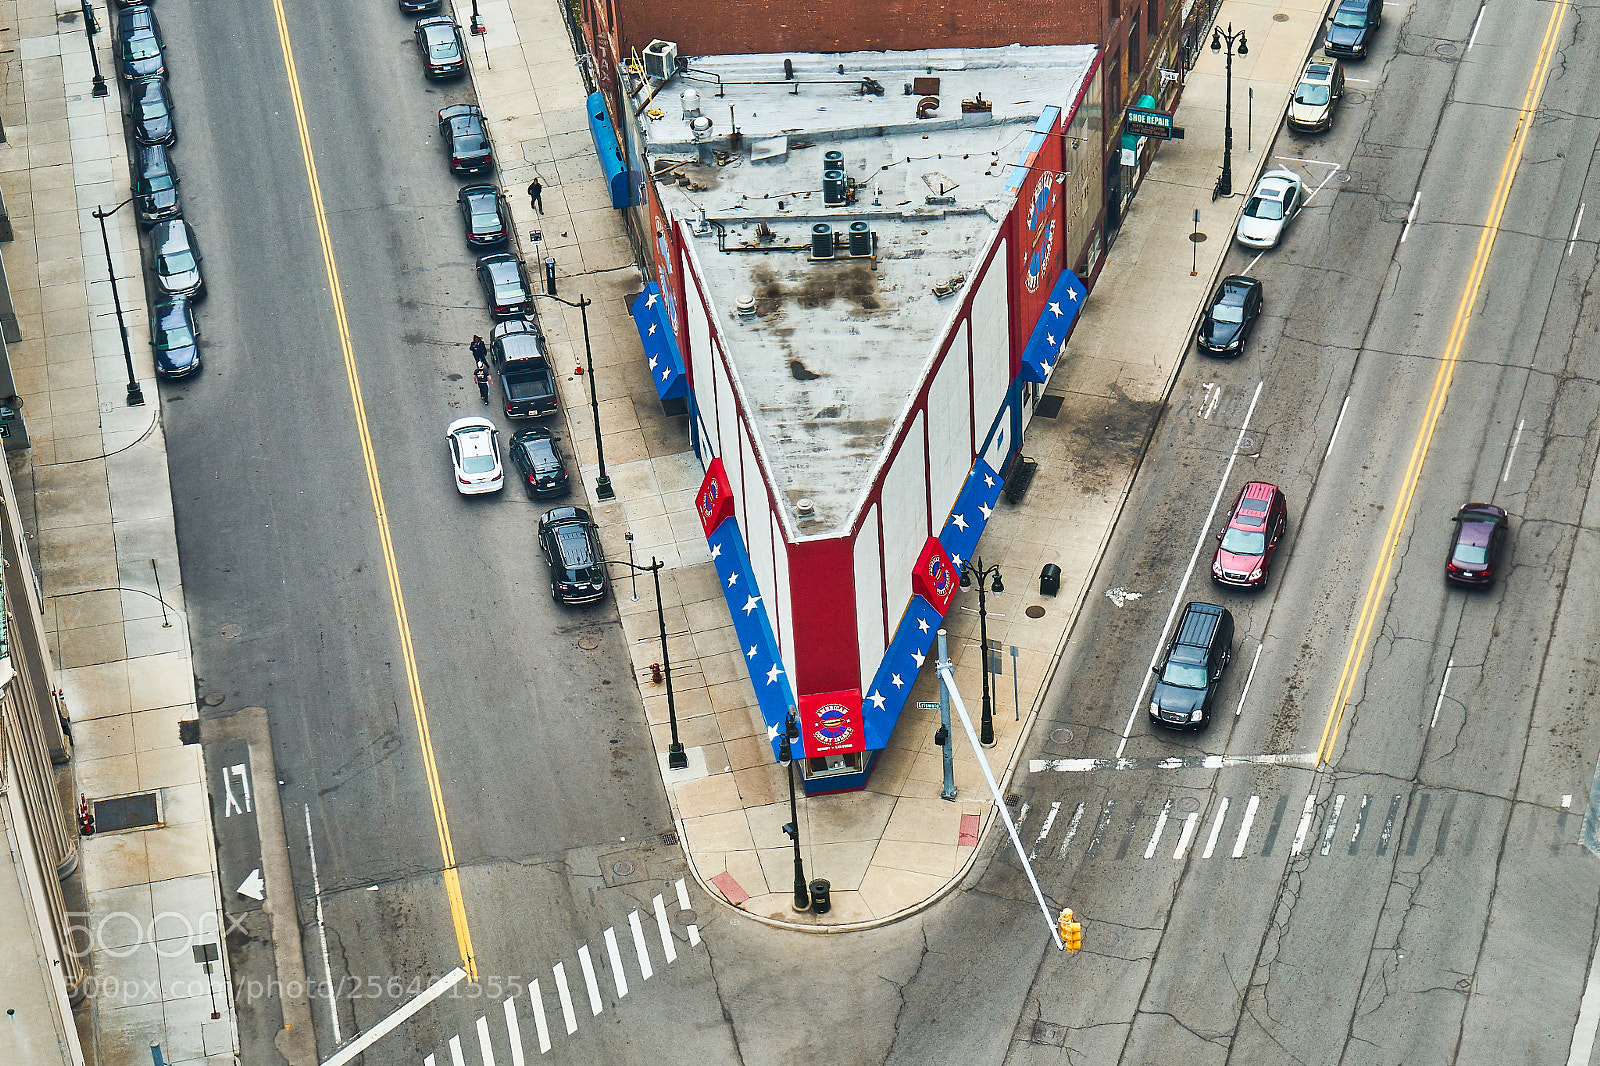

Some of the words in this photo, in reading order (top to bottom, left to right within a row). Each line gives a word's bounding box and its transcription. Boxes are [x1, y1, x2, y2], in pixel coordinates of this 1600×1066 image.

[598, 45, 611, 81] TAX
[1128, 113, 1146, 123] SHOE
[1147, 116, 1169, 126] REPAIR
[815, 703, 850, 718] AMERICAN
[812, 730, 833, 745] CONEY
[833, 726, 854, 745] ISLAND
